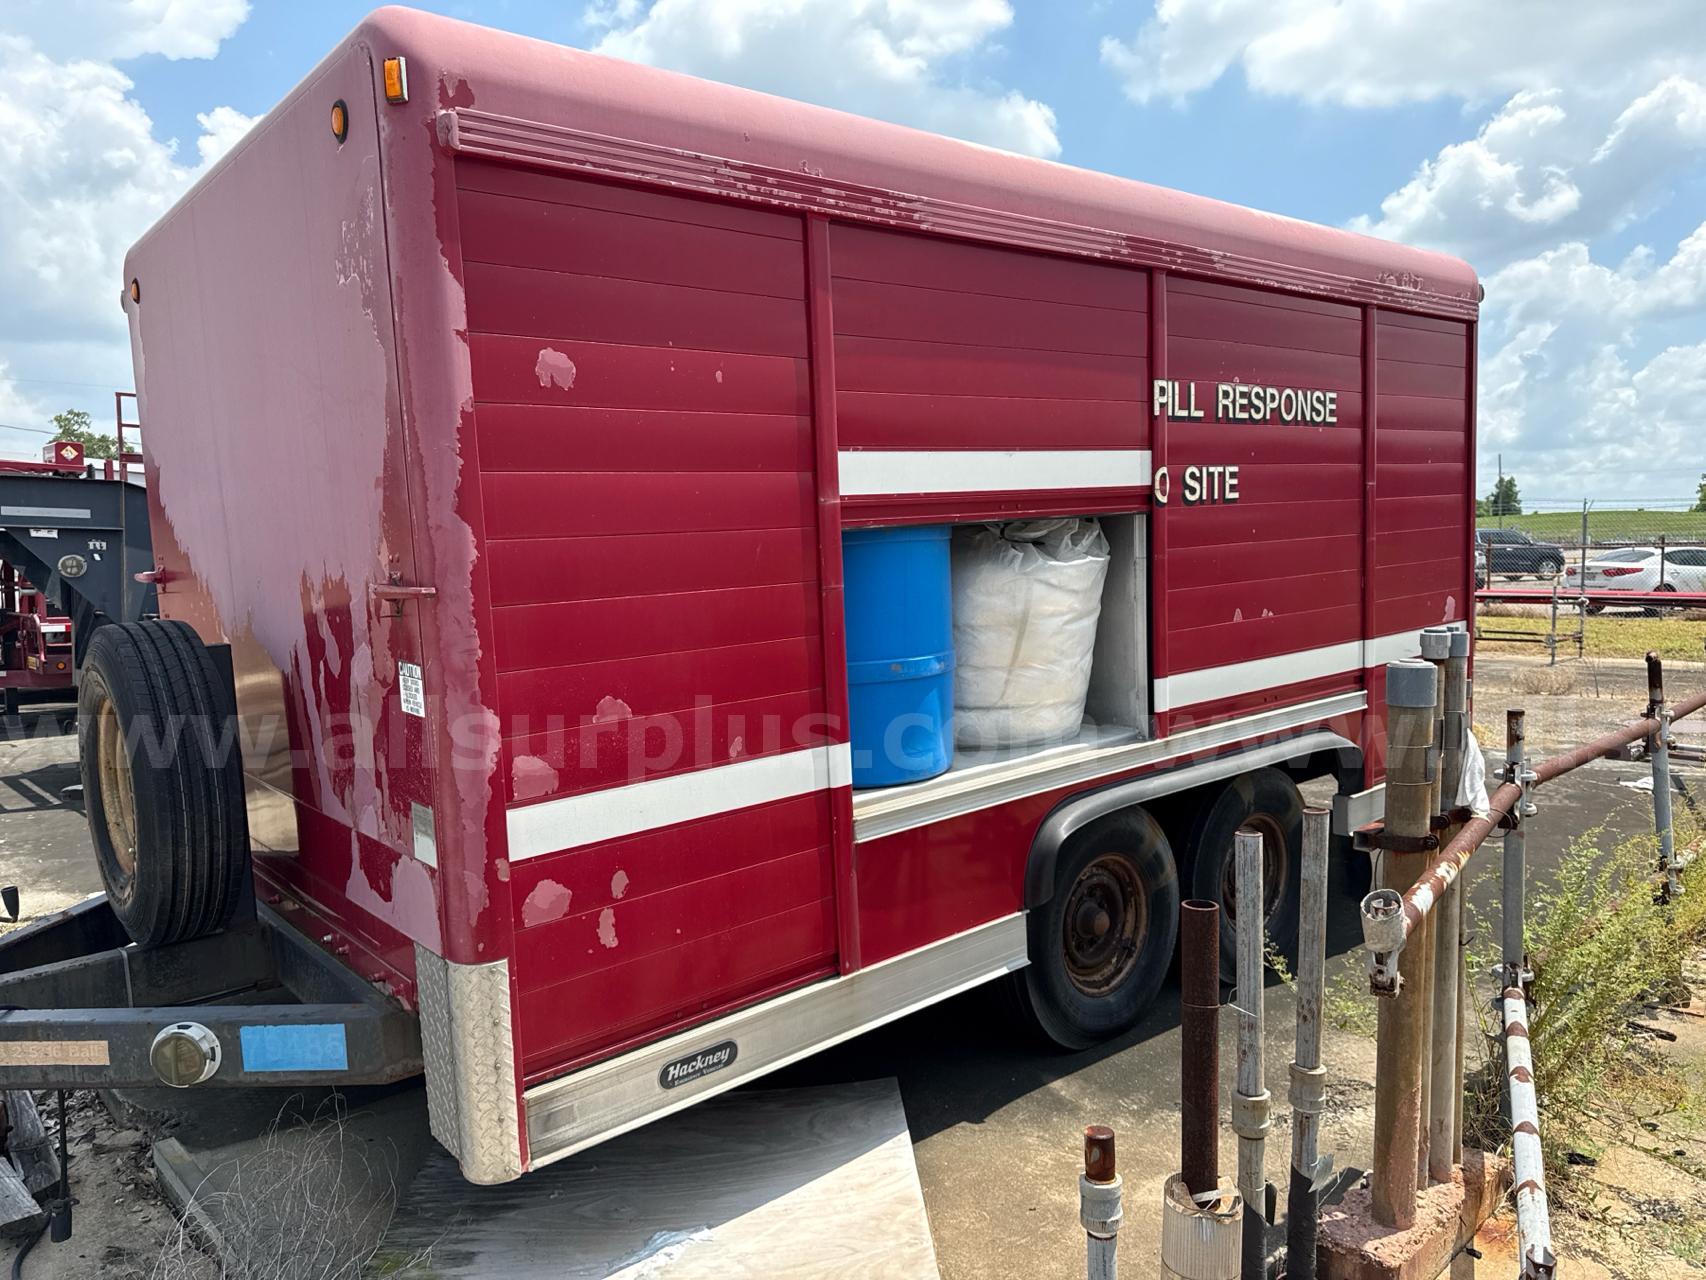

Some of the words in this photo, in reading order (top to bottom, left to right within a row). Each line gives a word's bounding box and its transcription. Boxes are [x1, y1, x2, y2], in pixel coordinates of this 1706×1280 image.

[1153, 380, 1204, 418] PILL
[1217, 383, 1339, 423] RESPONSE
[1184, 466, 1240, 502] SITE
[667, 1047, 730, 1081] Hackney
